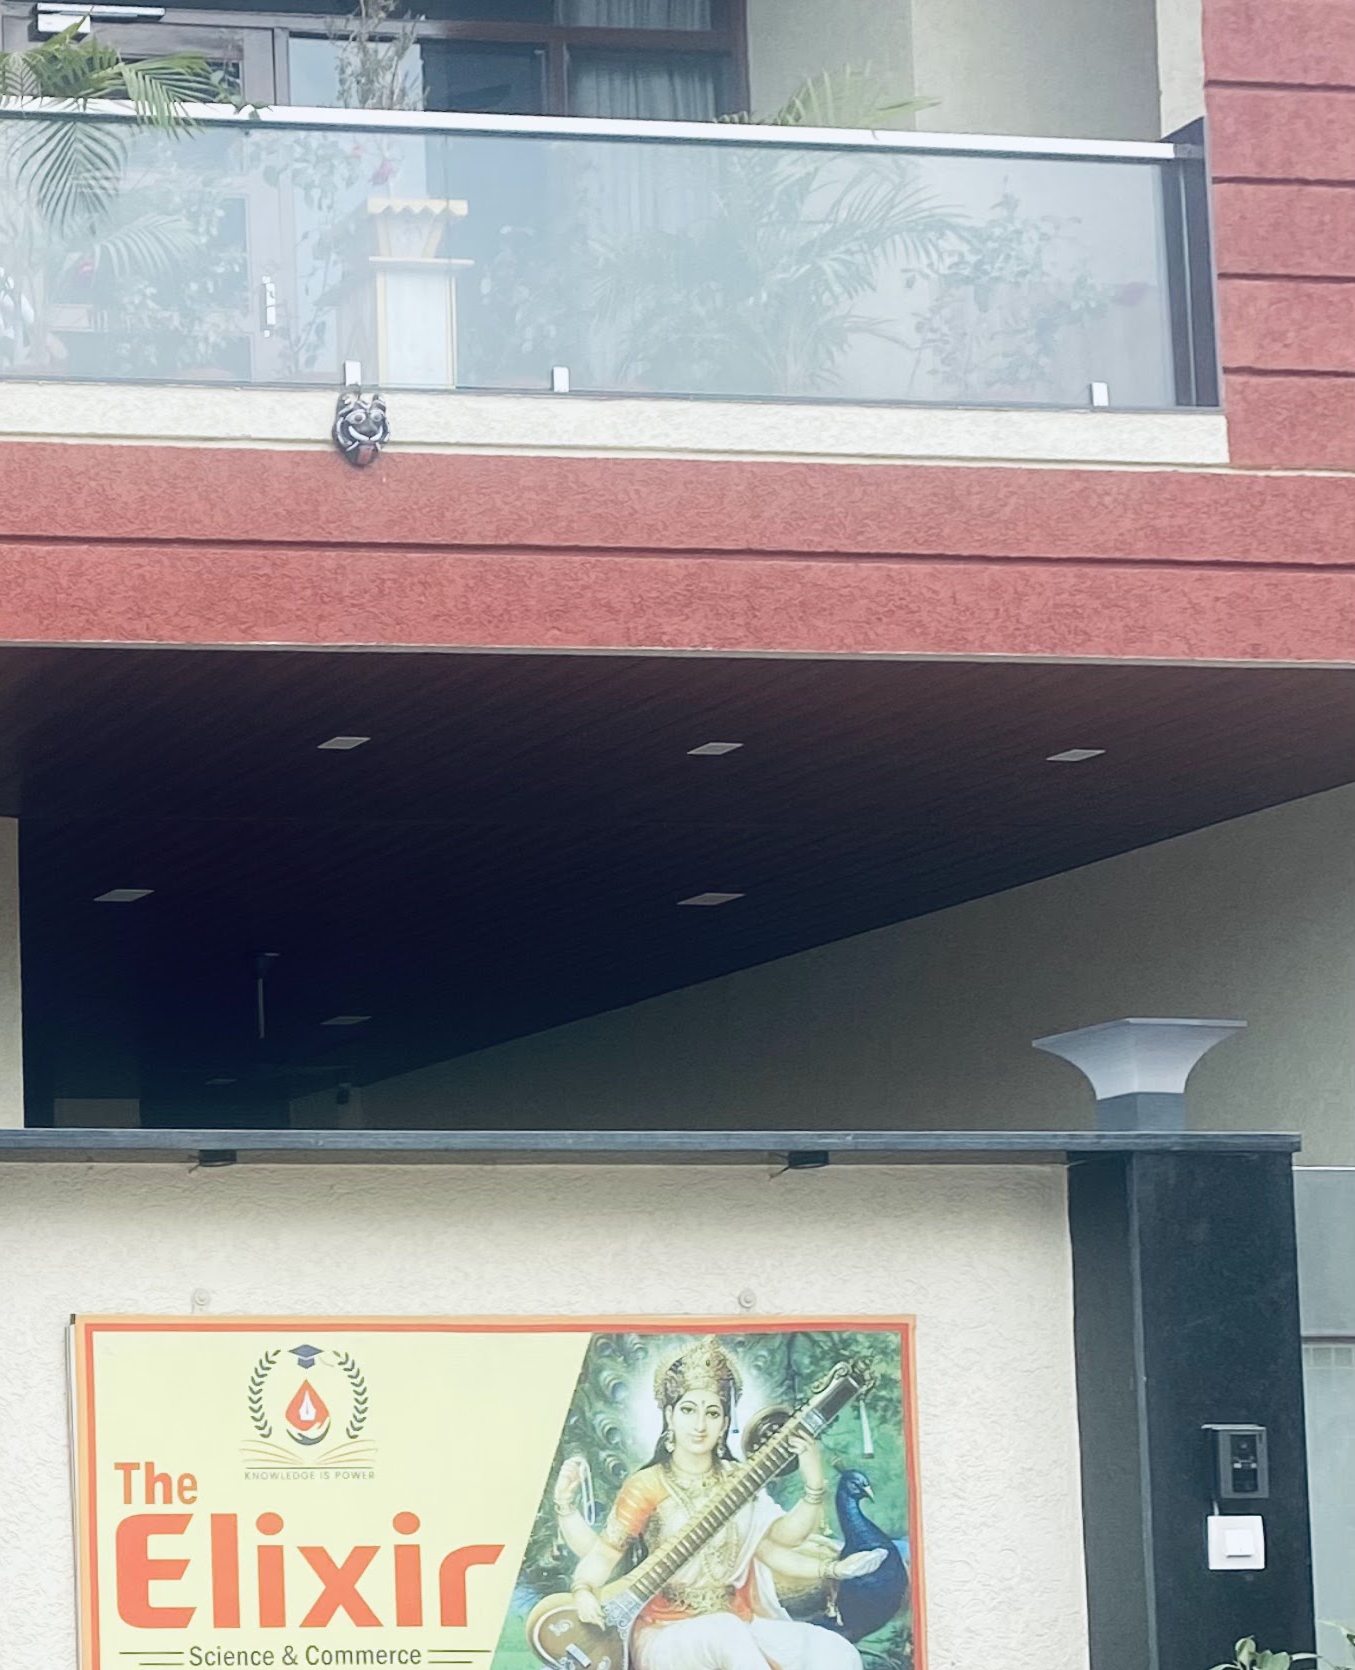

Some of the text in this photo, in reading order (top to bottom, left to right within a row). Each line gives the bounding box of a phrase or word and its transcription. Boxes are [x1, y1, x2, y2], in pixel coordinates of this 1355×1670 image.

[114, 1461, 198, 1504] The
[244, 1471, 375, 1481] KNOWLEDGE IS POWER
[115, 1511, 506, 1629] Elixir
[189, 1644, 422, 1667] Science & Commerce
